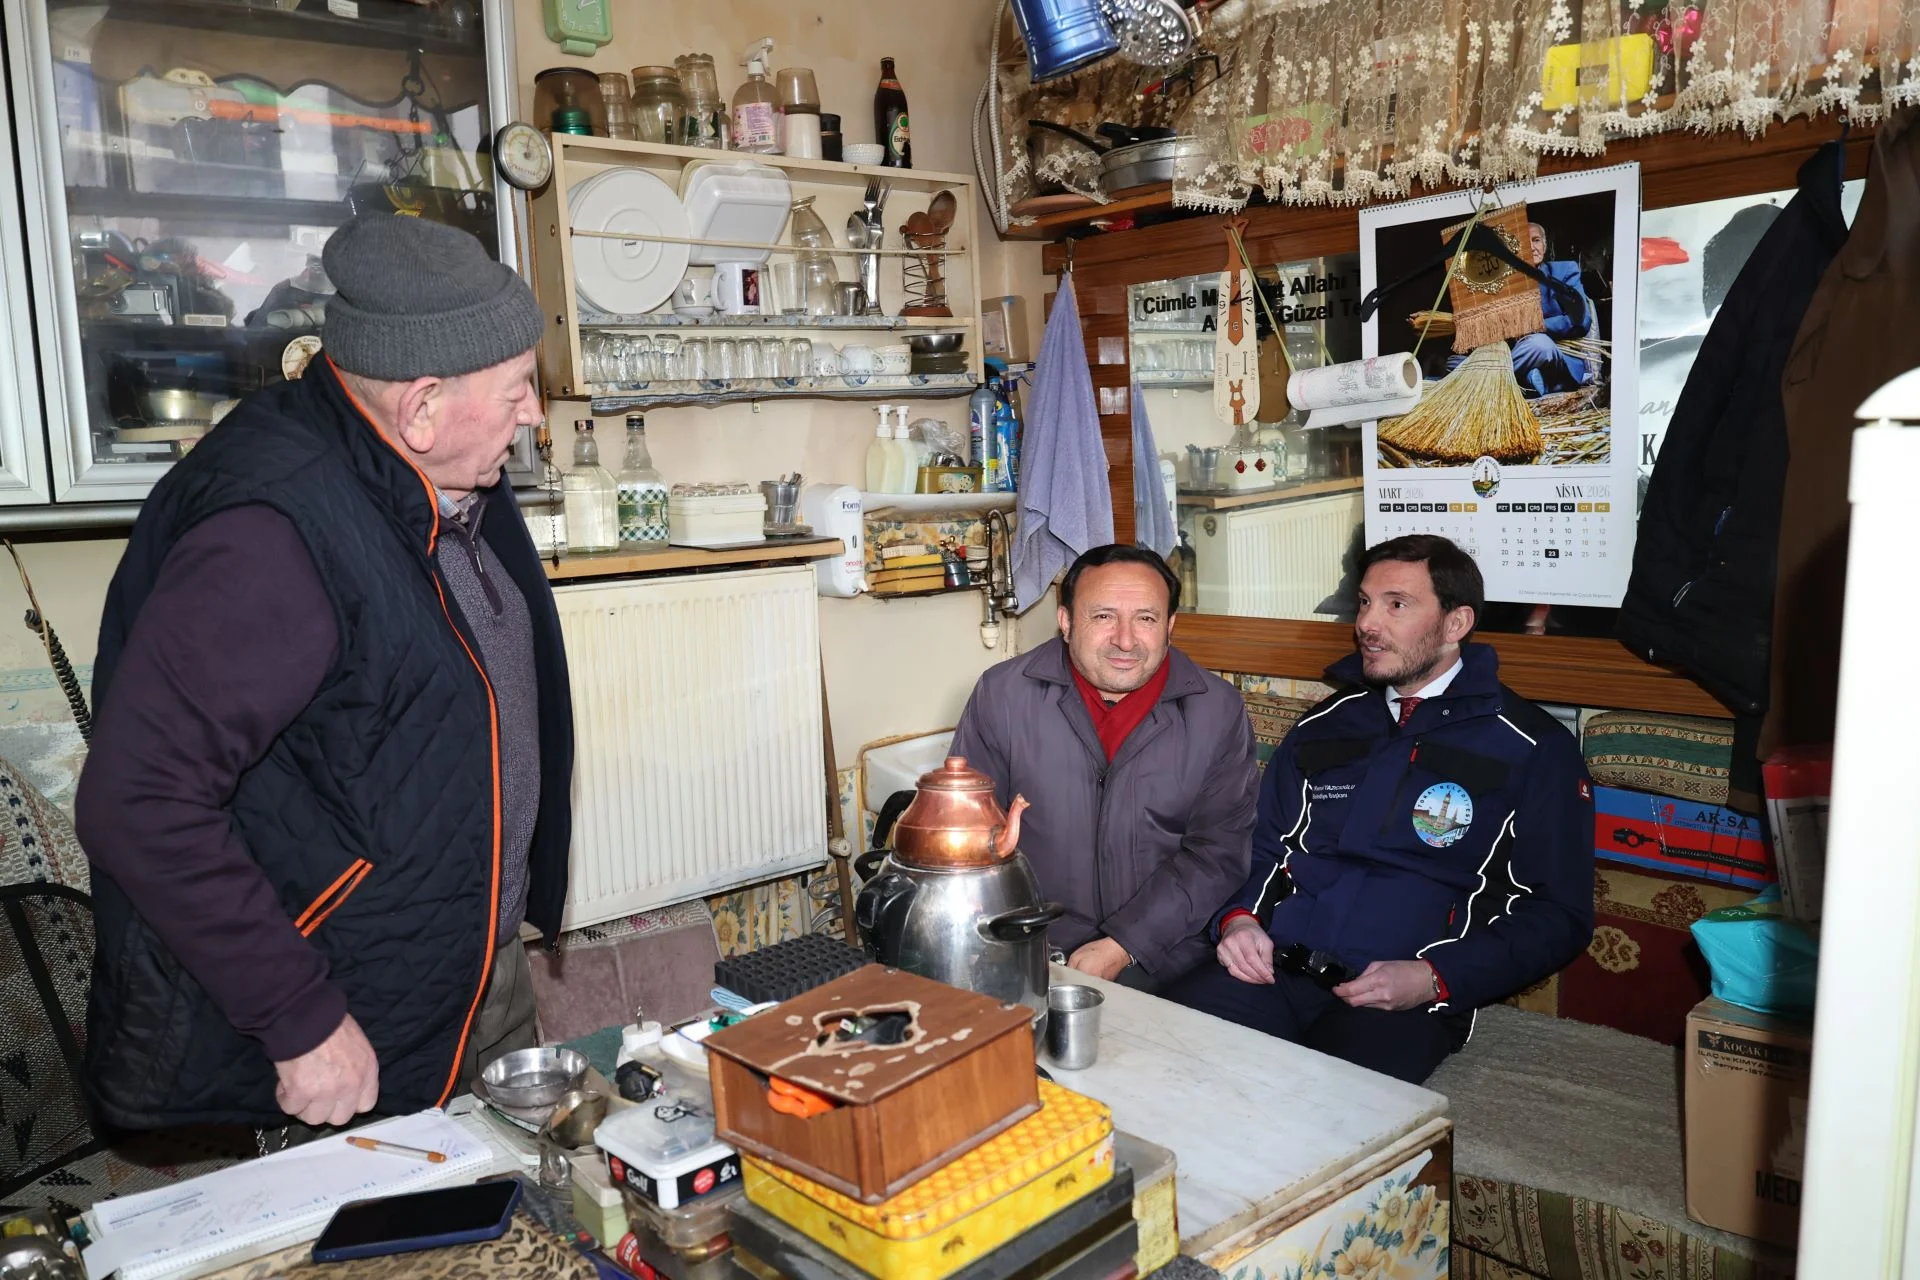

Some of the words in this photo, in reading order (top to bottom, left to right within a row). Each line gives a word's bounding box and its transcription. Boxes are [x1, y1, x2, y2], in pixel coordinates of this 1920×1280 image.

[1144, 292, 1197, 314] Cümle
[1279, 301, 1333, 323] Güzel
[1379, 487, 1402, 499] MART
[1555, 483, 1583, 499] NİSAN
[1587, 485, 1611, 498] 2026
[1695, 808, 1750, 830] AK-SA
[1723, 1040, 1761, 1057] KOÇAK
